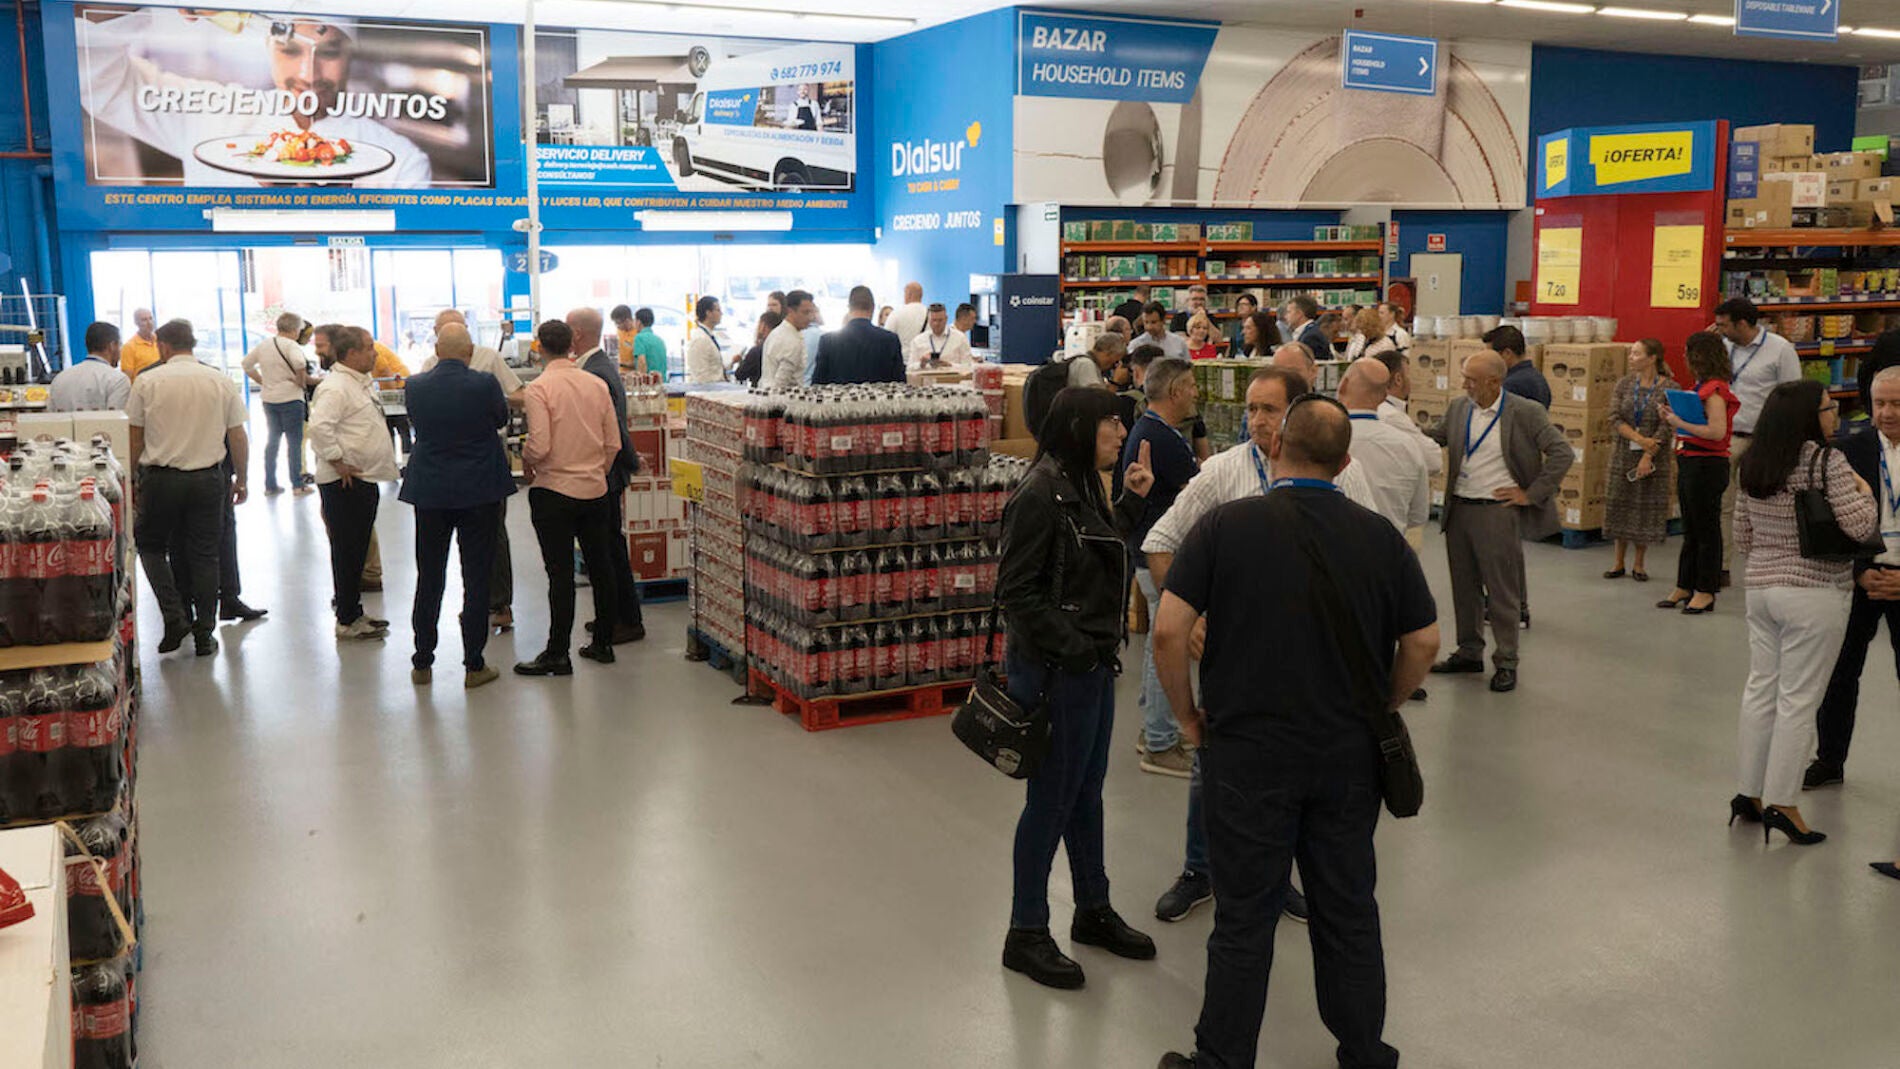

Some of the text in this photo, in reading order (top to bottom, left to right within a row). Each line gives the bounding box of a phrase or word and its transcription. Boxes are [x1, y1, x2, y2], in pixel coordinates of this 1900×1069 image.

[1032, 26, 1107, 52] BAZAR
[1353, 45, 1373, 53] BAZAR
[781, 61, 842, 79] 682 779 974
[1032, 63, 1185, 89] HOUSEHOLD ITEMS
[137, 86, 448, 120] CRECIENDO JUNTOS
[709, 97, 743, 109] Dialsur
[536, 147, 646, 160] SERVICIO DELIVERY
[892, 139, 965, 177] Dialsur
[1603, 147, 1683, 163] ¡OFERTA!
[105, 194, 134, 204] ESTE
[136, 194, 184, 204] CENTRO
[186, 194, 232, 205] EMPLEA
[235, 194, 291, 205] SISTEMAS
[294, 195, 308, 205] DE
[310, 193, 356, 205] ENERGÍA
[358, 195, 418, 205] EFICIENTES
[420, 195, 451, 206] COMO
[452, 196, 493, 206] PLACAS
[542, 196, 549, 206] Y
[550, 197, 580, 206] LUCES
[603, 197, 623, 207] QUE
[624, 197, 688, 207] CONTRIBUYEN
[689, 198, 697, 207] A
[698, 198, 731, 208] CUIDAR
[733, 198, 774, 208] NUESTRO
[776, 199, 803, 208] MEDIO
[805, 199, 848, 209] AMBIENTE
[893, 210, 981, 231] CRECIENDO JUNTOS
[516, 258, 549, 272] 2 1
[1022, 296, 1055, 306] coinstar
